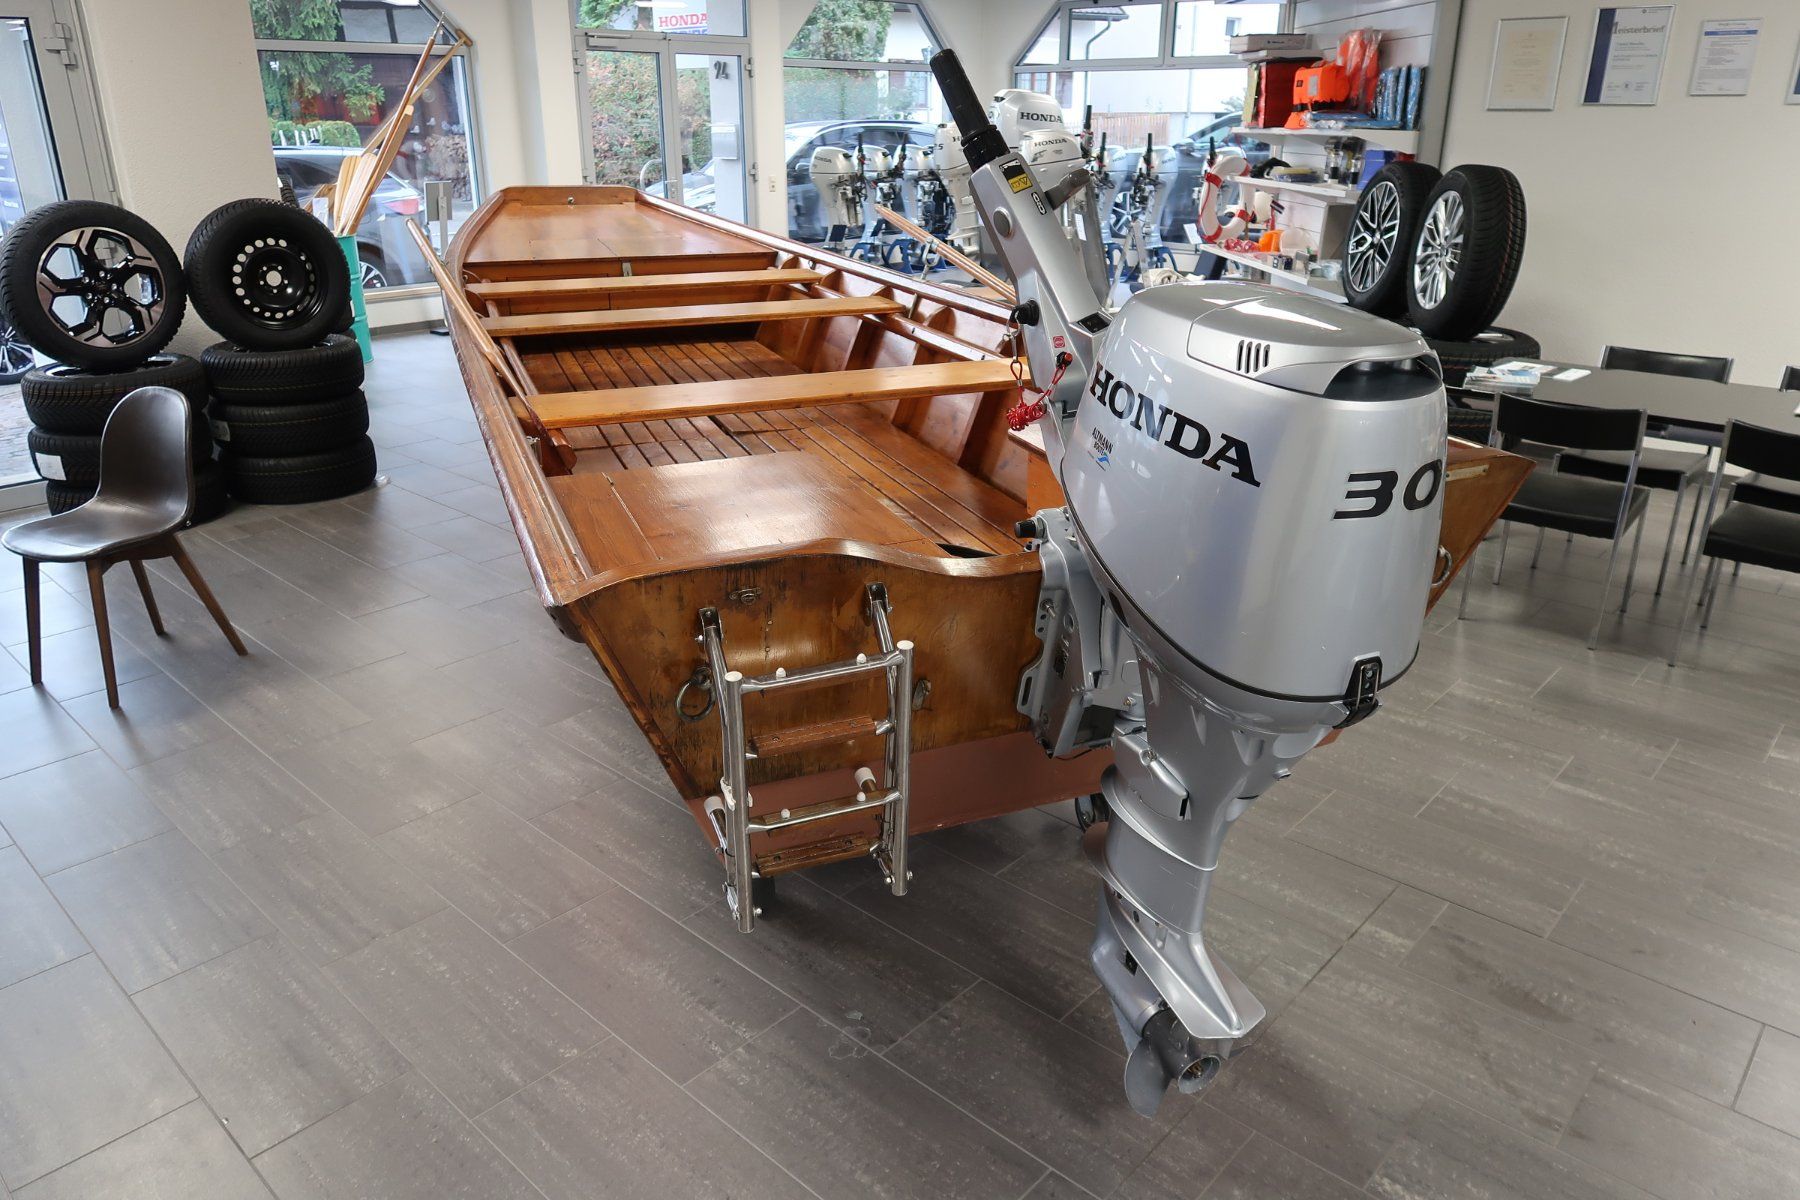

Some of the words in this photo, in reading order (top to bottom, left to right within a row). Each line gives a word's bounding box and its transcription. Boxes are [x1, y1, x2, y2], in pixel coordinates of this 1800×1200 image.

[658, 13, 708, 27] HONDA
[1019, 111, 1063, 124] HONDA
[1033, 138, 1067, 147] HONDA
[1089, 361, 1261, 488] HONDA
[1333, 459, 1442, 520] 30
